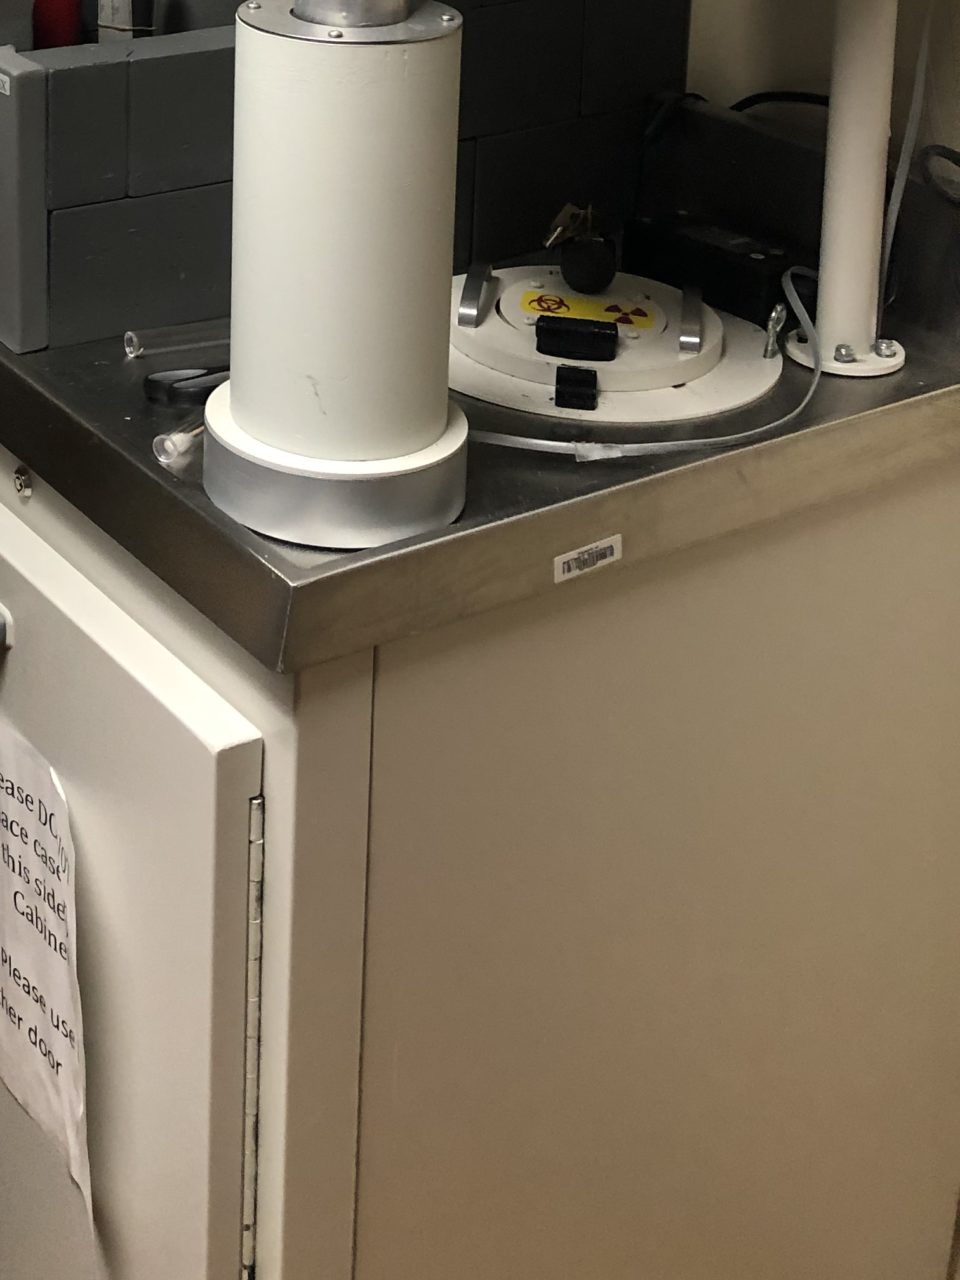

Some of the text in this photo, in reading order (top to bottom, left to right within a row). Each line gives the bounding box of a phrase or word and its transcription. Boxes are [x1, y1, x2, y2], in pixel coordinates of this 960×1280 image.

[1, 842, 66, 921] this side
[13, 890, 69, 963] Cabine
[28, 1024, 63, 1076] door
[50, 1008, 76, 1050] use
